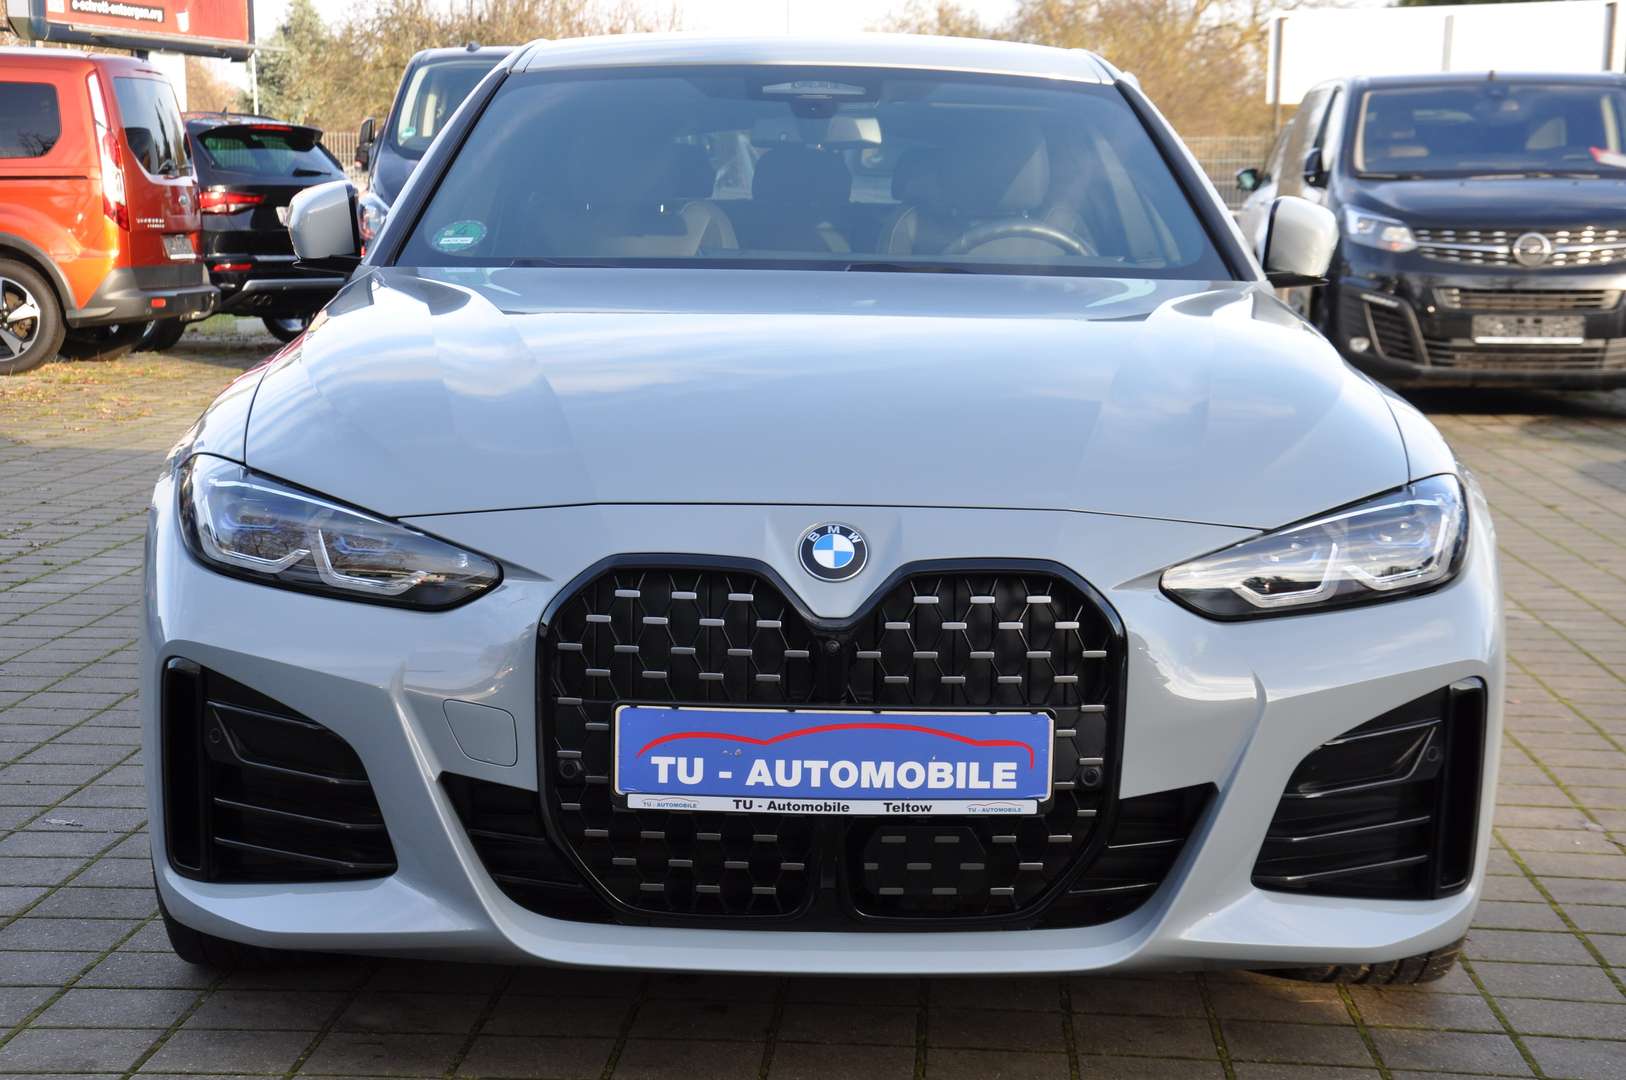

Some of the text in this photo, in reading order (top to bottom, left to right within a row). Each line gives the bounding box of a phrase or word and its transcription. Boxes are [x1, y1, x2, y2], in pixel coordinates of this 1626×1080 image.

[807, 525, 861, 544] BMW
[650, 756, 1018, 789] TU - AUTOMOBILE
[656, 801, 697, 809] AUTOMOBILE
[732, 799, 753, 810] TU
[766, 800, 850, 813] Automobile
[883, 802, 933, 813] Teltow
